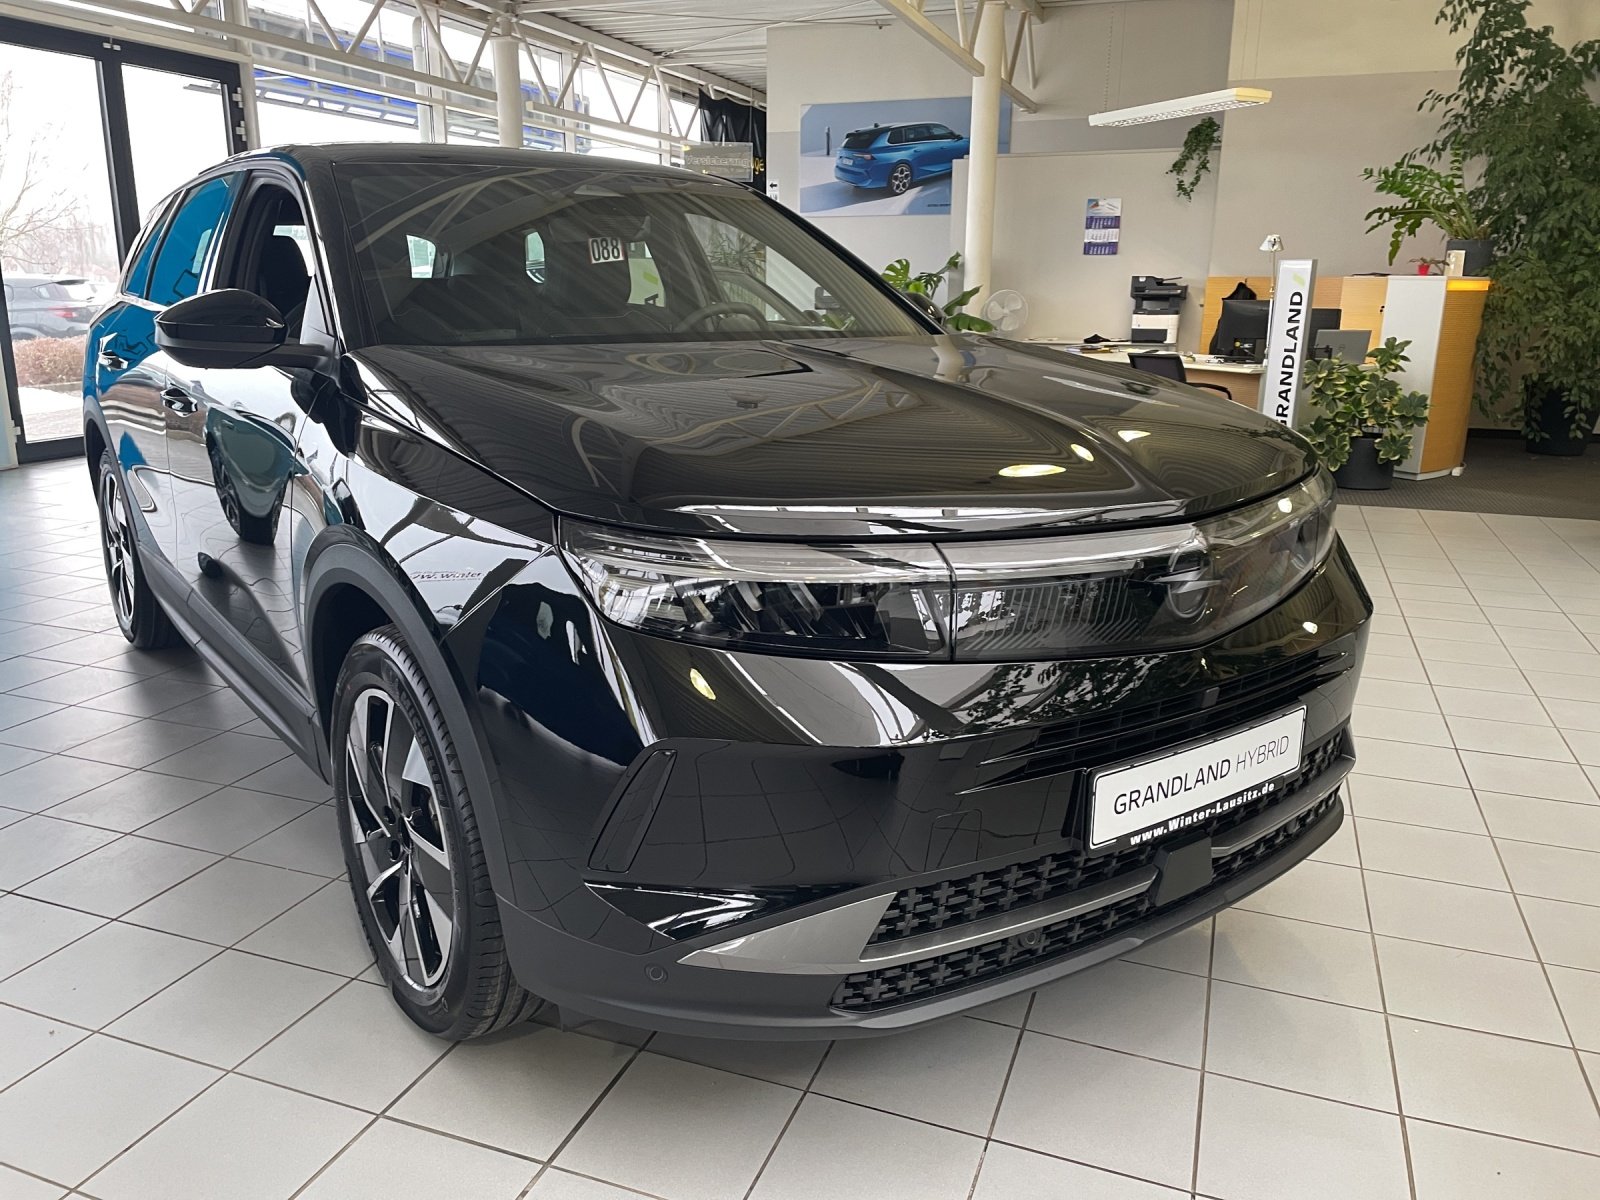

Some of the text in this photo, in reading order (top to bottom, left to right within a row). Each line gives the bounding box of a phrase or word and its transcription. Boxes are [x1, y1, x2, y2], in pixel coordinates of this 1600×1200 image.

[591, 237, 621, 261] 088
[1113, 735, 1290, 815] GRANDLAND HYBRID
[1129, 781, 1275, 846] www.Winter-Lausitz.de
